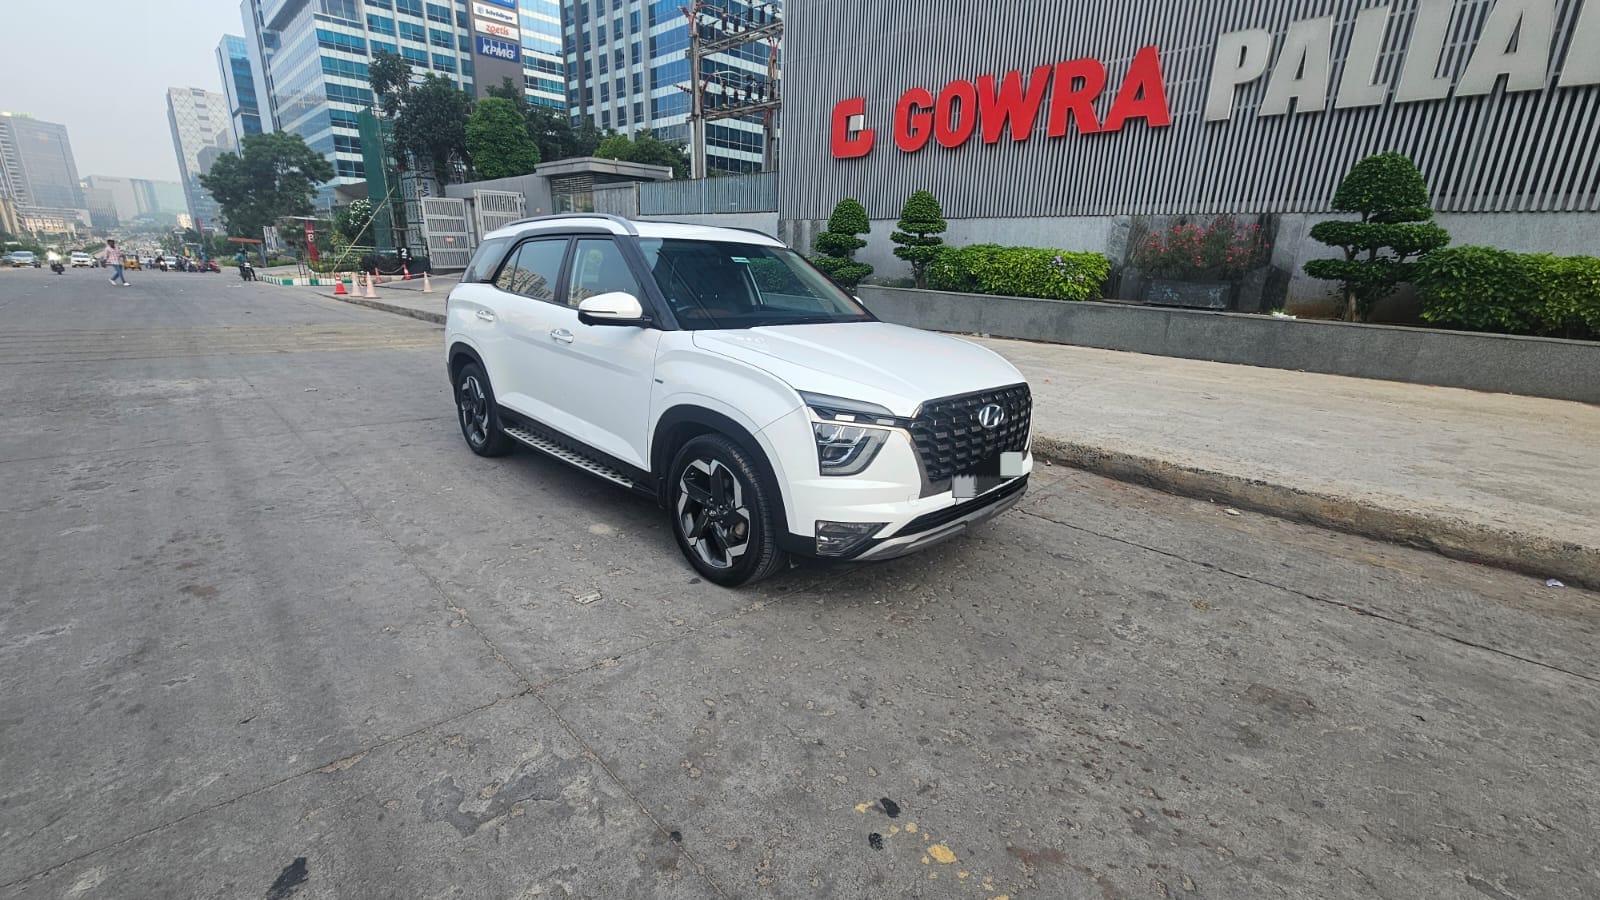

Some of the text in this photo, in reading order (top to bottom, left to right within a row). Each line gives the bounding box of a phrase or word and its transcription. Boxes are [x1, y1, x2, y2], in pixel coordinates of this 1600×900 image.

[486, 25, 509, 35] zoetis
[482, 44, 515, 60] KPMG
[893, 45, 1171, 152] GOWRA
